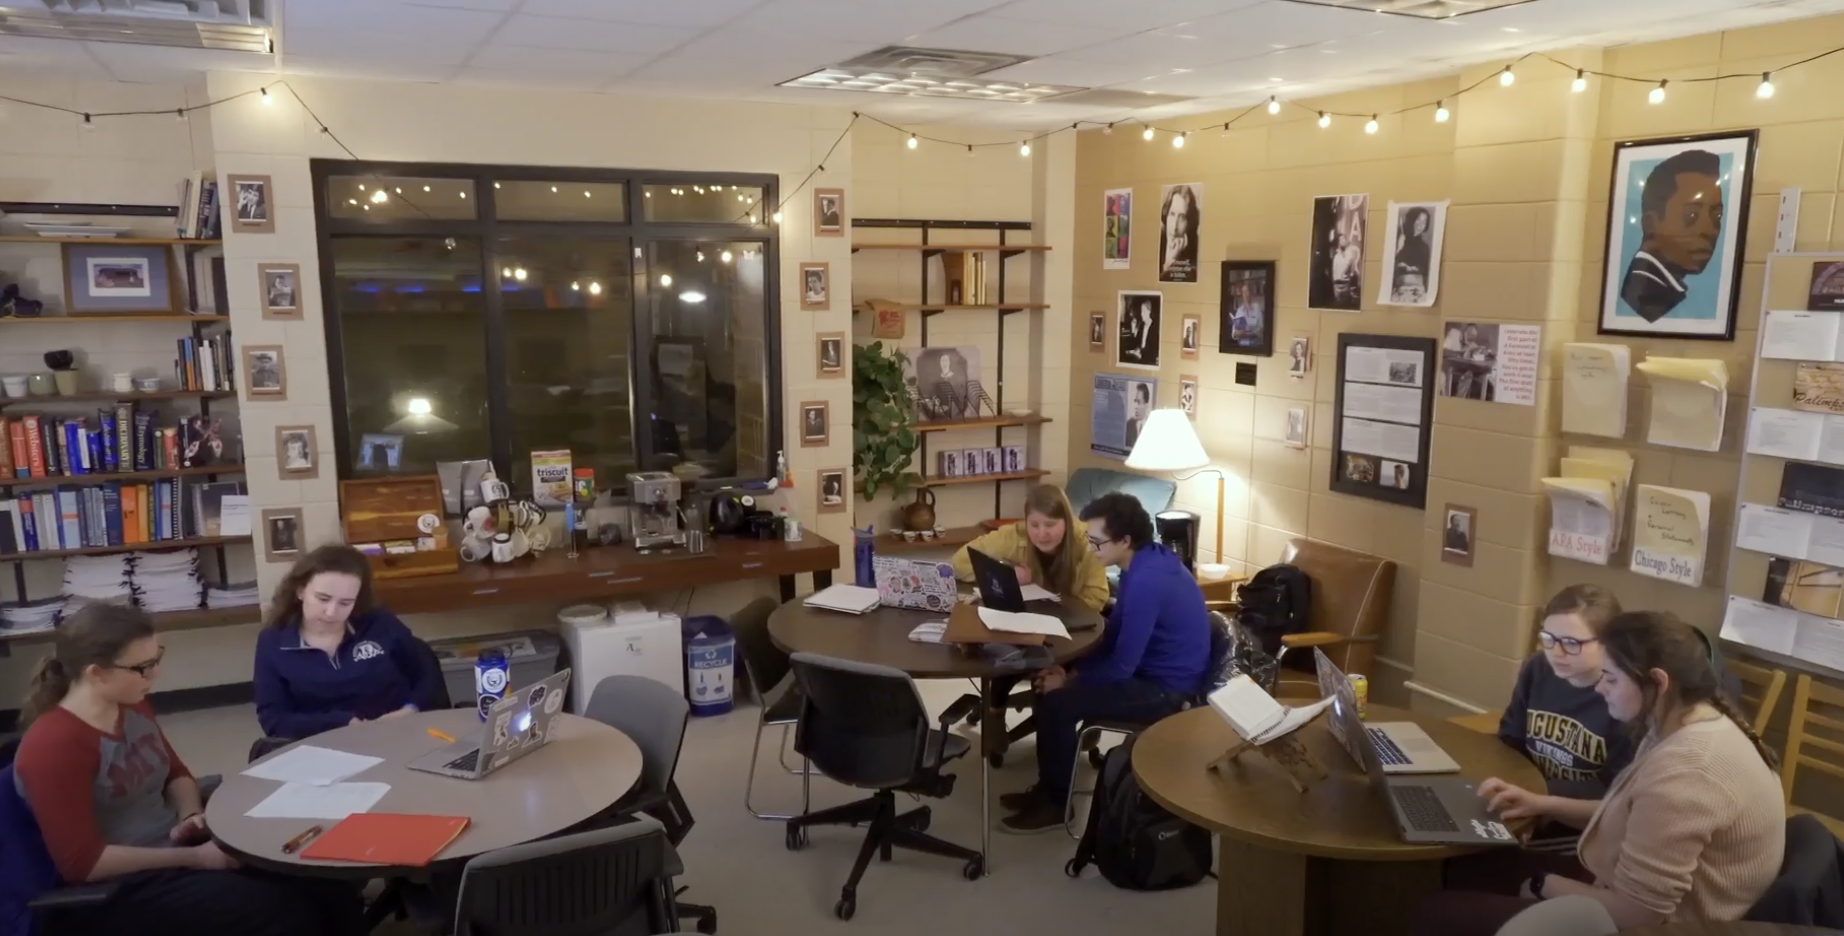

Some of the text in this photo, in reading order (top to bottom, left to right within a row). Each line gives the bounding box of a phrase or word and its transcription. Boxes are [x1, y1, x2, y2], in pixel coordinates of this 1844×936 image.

[537, 467, 568, 477] triscuit
[1552, 532, 1602, 558] APA Style
[1634, 549, 1692, 580] Chicago Style
[693, 658, 728, 669] RECYCLE
[1535, 740, 1574, 767] VIKINGS
